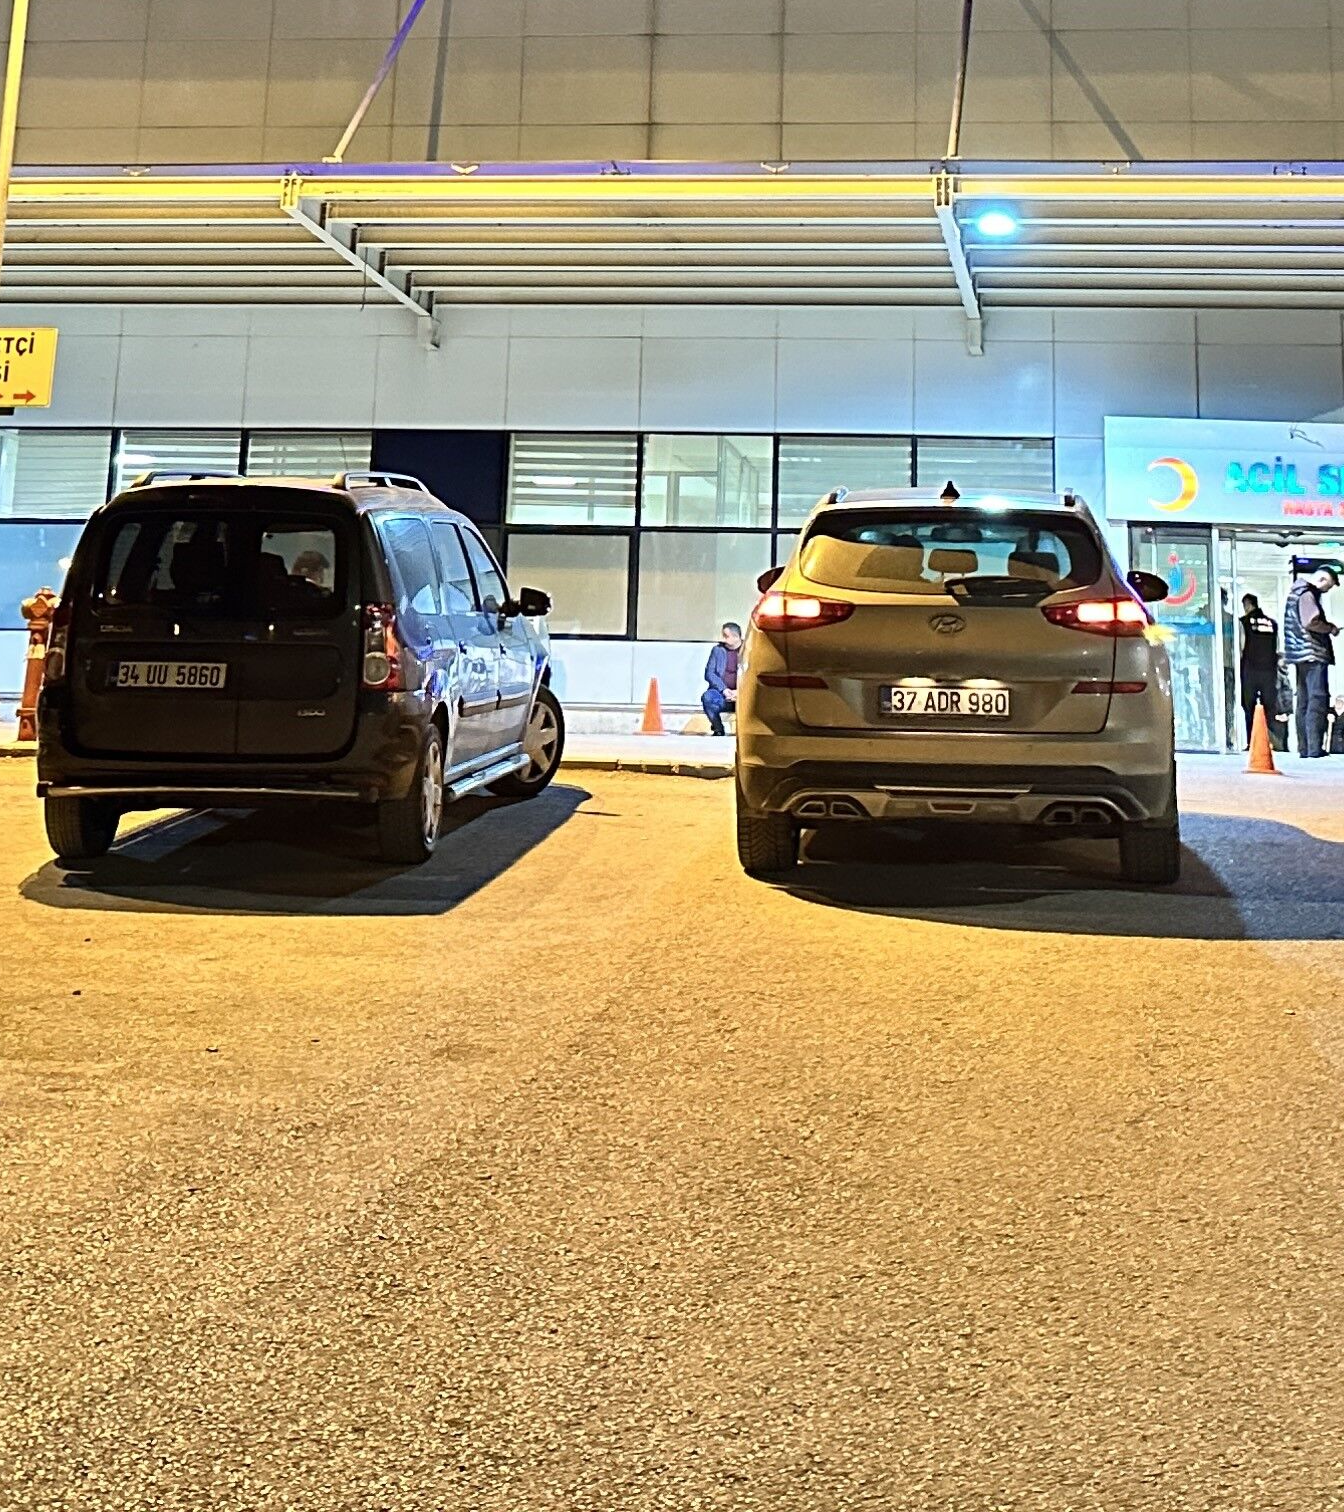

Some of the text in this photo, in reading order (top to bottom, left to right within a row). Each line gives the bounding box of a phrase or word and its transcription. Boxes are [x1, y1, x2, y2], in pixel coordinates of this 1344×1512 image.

[1225, 456, 1305, 495] ACİL
[119, 665, 140, 684] 34
[175, 665, 220, 687] 5860
[893, 691, 1007, 714] 37 ADR 980
